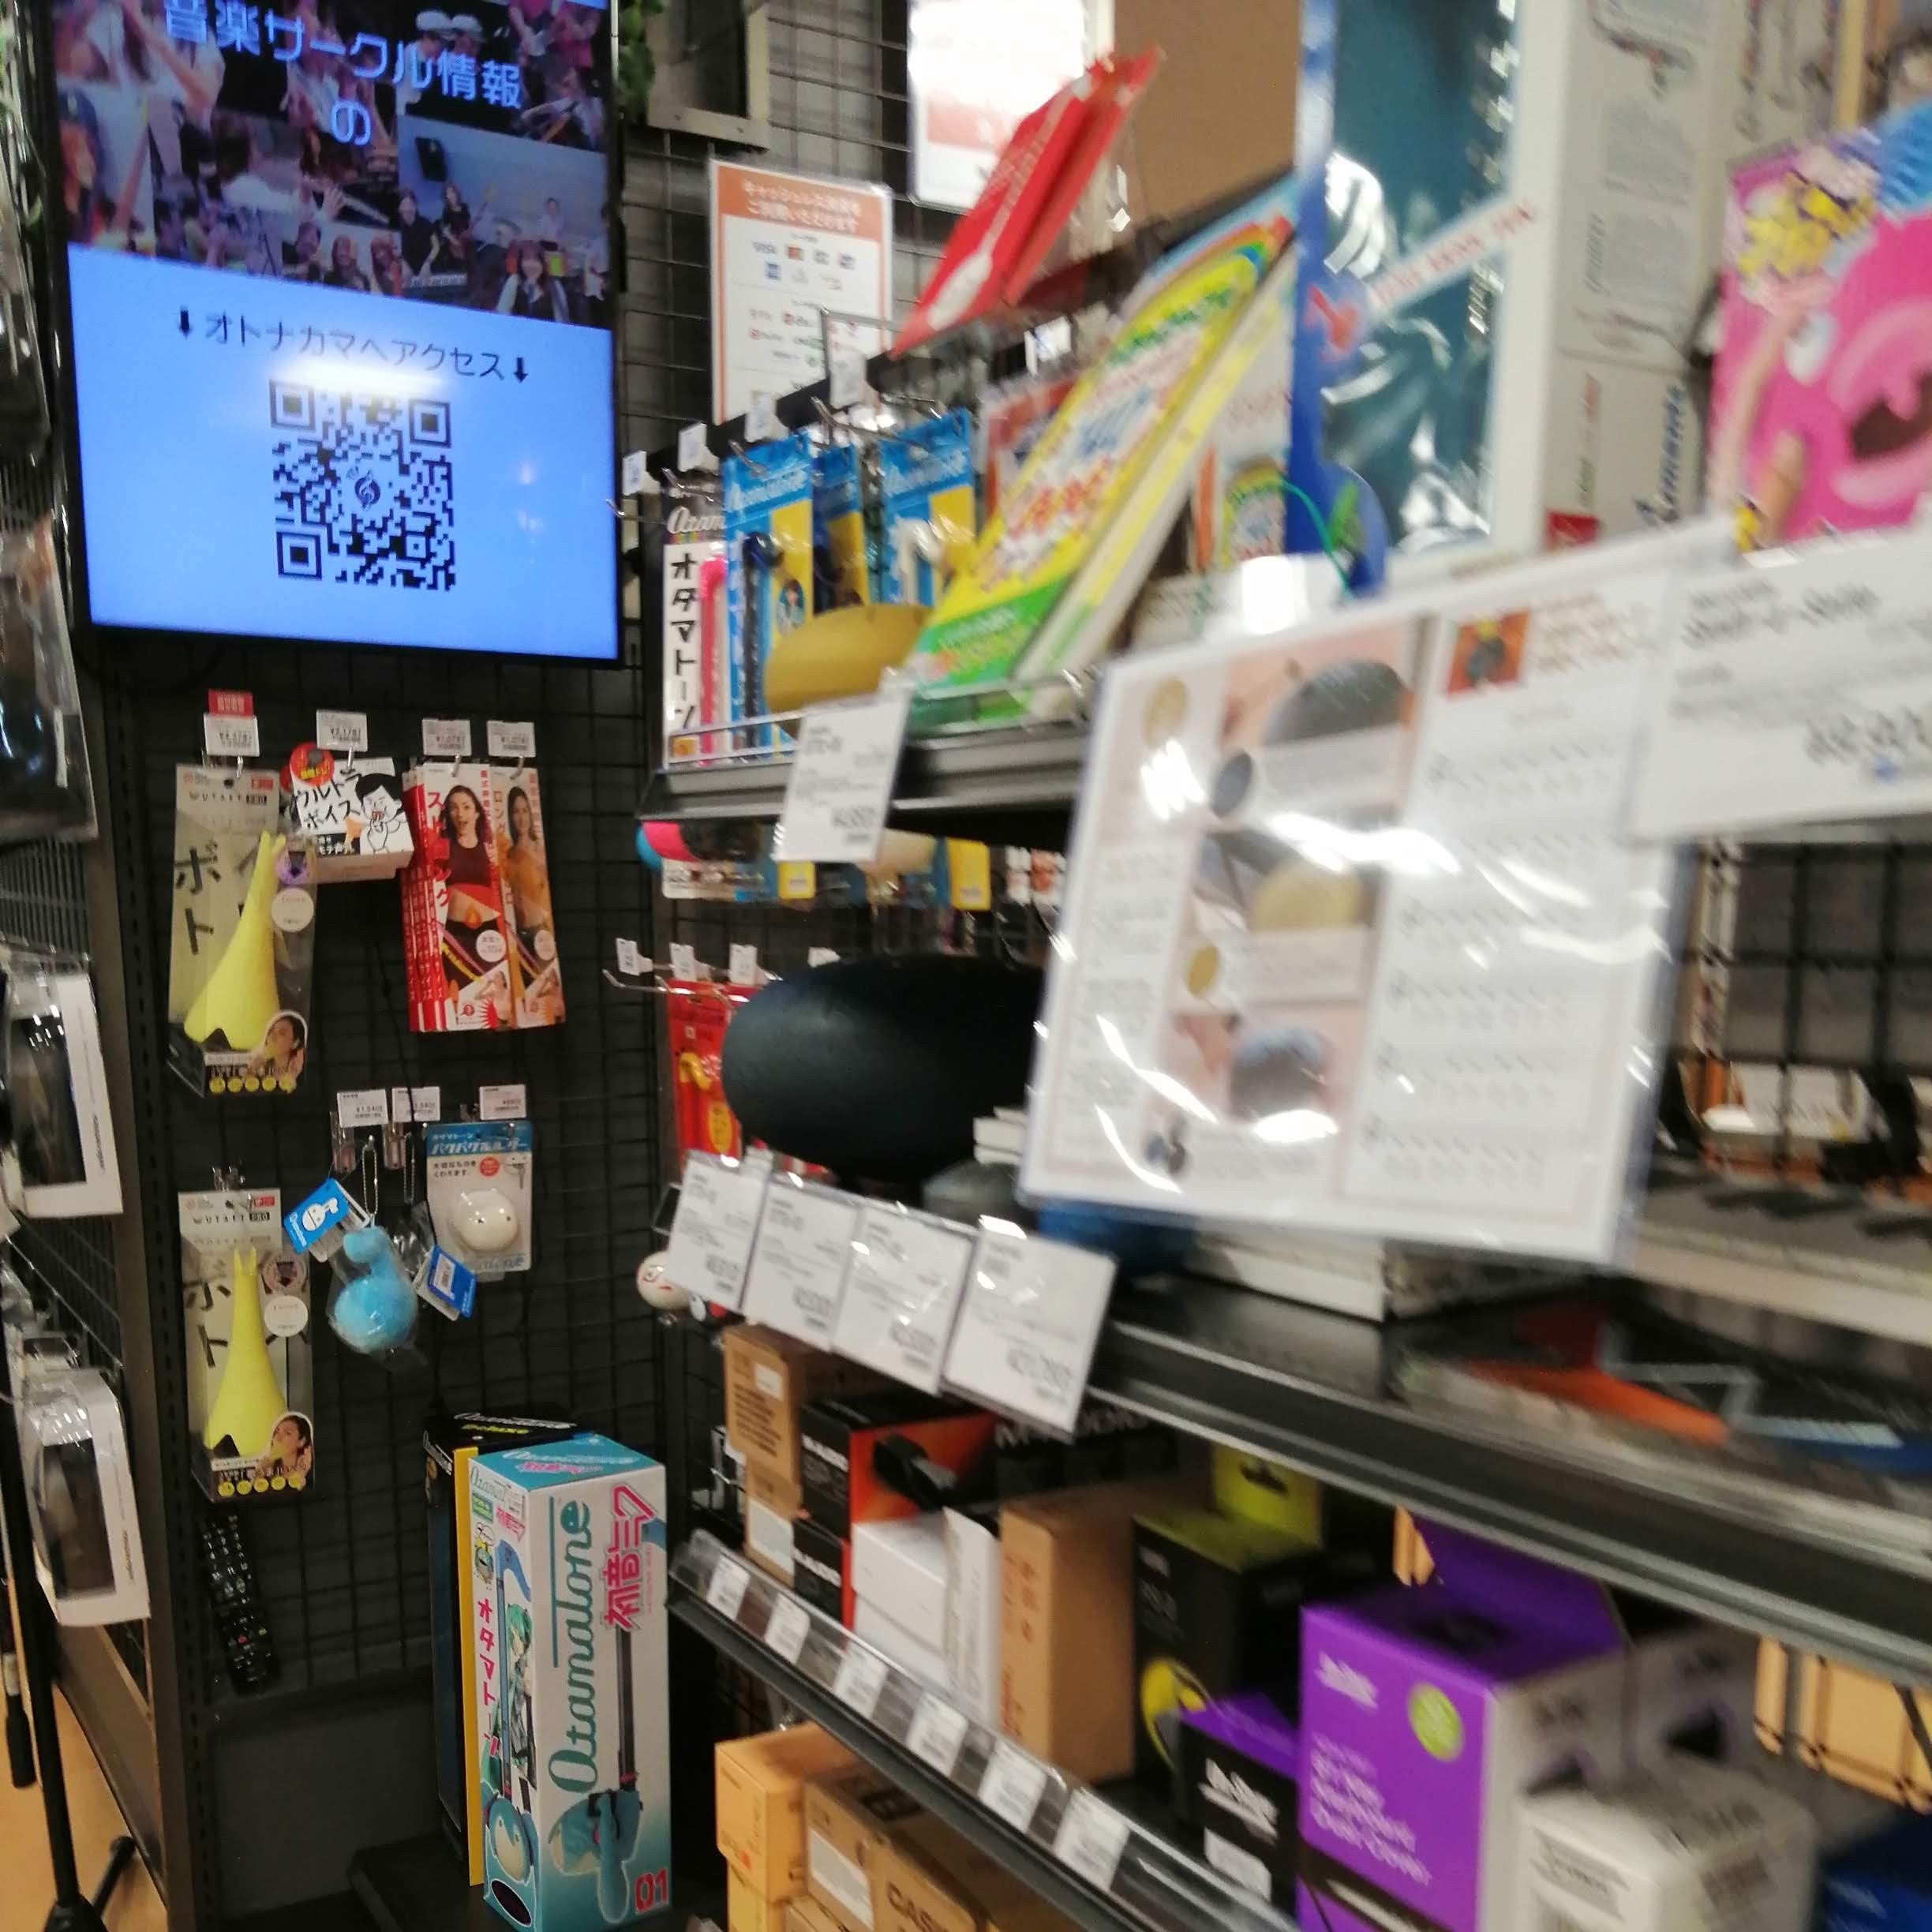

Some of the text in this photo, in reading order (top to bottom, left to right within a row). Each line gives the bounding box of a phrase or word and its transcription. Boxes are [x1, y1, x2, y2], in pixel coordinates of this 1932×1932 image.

[163, 0, 522, 110] 音楽サークル情報
[329, 100, 373, 146] の
[671, 552, 698, 729] オタマトーン
[601, 1484, 656, 1631] 初音ミク
[548, 1496, 598, 1793] Otamatone
[634, 1869, 668, 1913] 01
